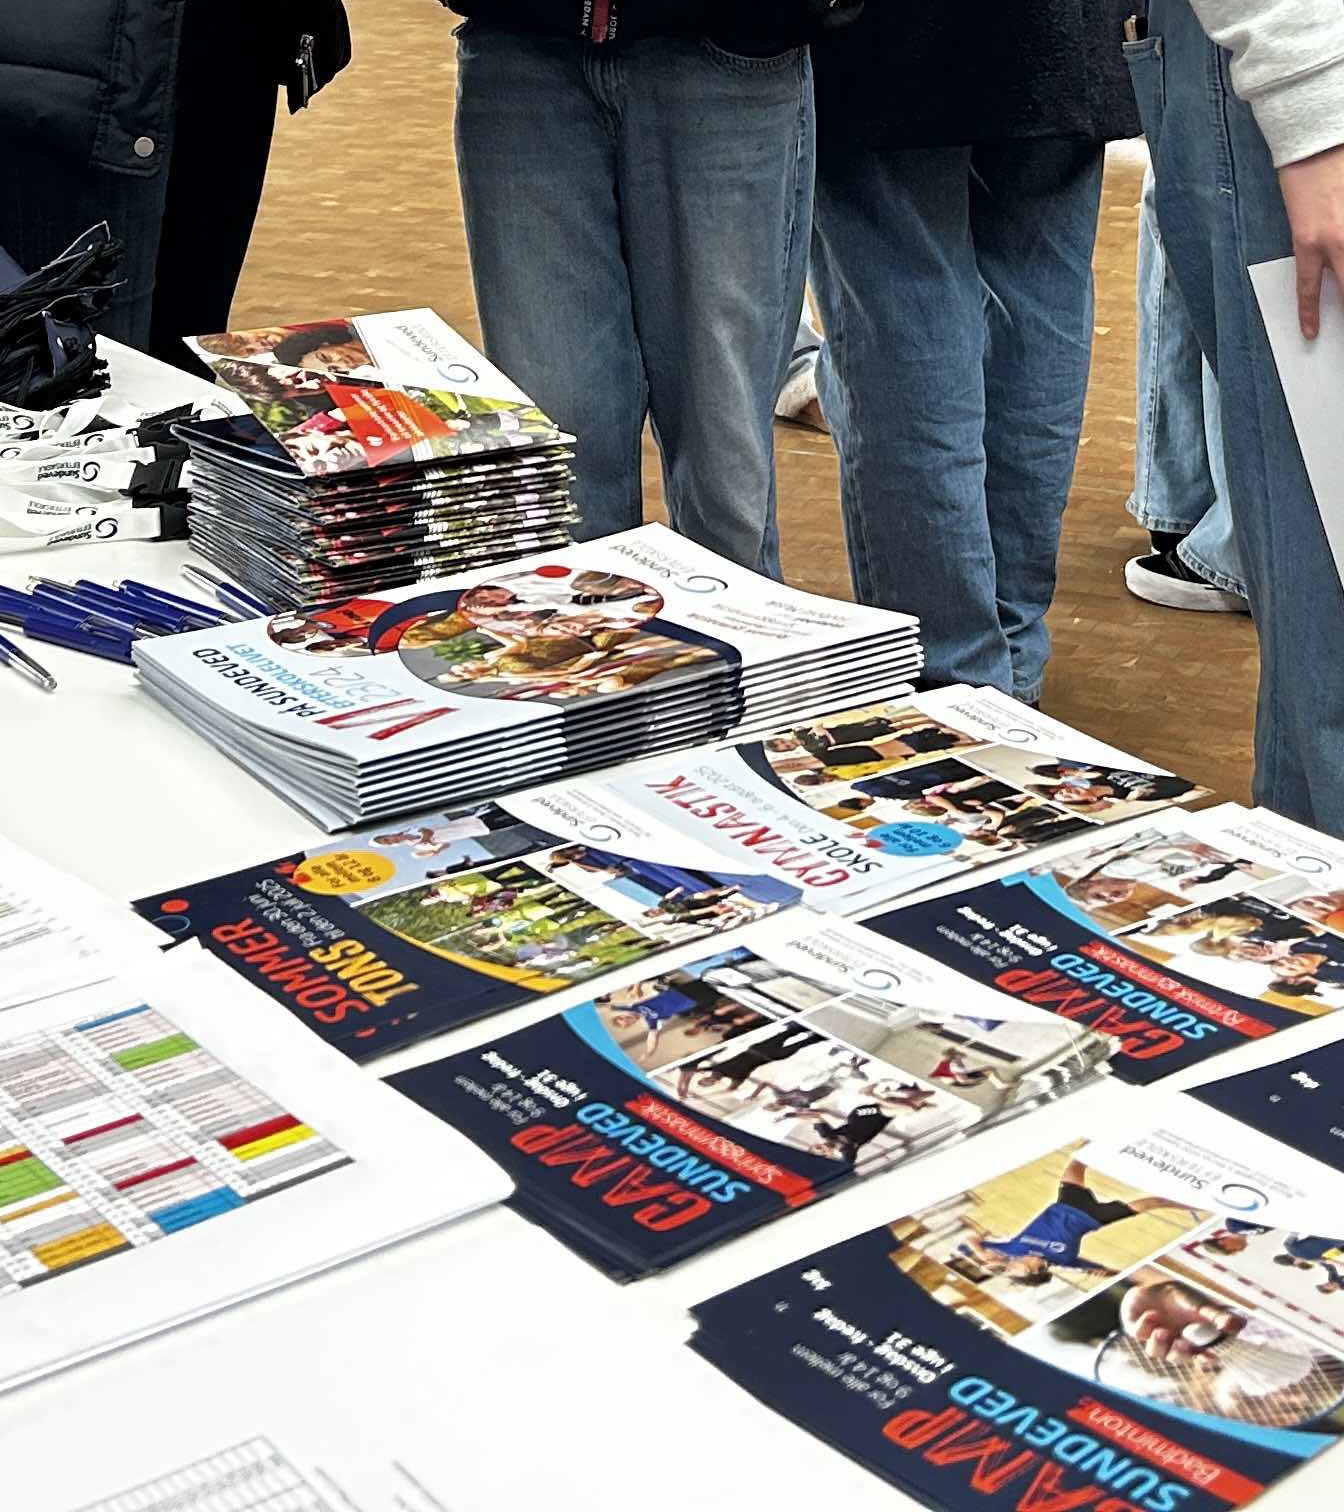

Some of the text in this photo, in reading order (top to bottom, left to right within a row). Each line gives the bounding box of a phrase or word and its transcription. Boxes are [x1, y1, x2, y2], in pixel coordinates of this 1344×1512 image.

[37, 470, 81, 482] Sundeved
[192, 648, 299, 710] SUNDEVED
[645, 775, 851, 888] GYMNASTIK
[800, 832, 884, 874] SKOLE
[211, 917, 370, 1024] SOMMER
[308, 938, 420, 1007] TONS
[994, 968, 1184, 1060] CAMP
[1050, 953, 1218, 1040] SUNDEVED
[510, 1123, 712, 1232] CAMP
[576, 1101, 752, 1203] SUNDEVED
[881, 1405, 1116, 1512] AMP
[948, 1375, 1192, 1512] SUNDEVED
[1086, 1405, 1223, 1487] Badminton
